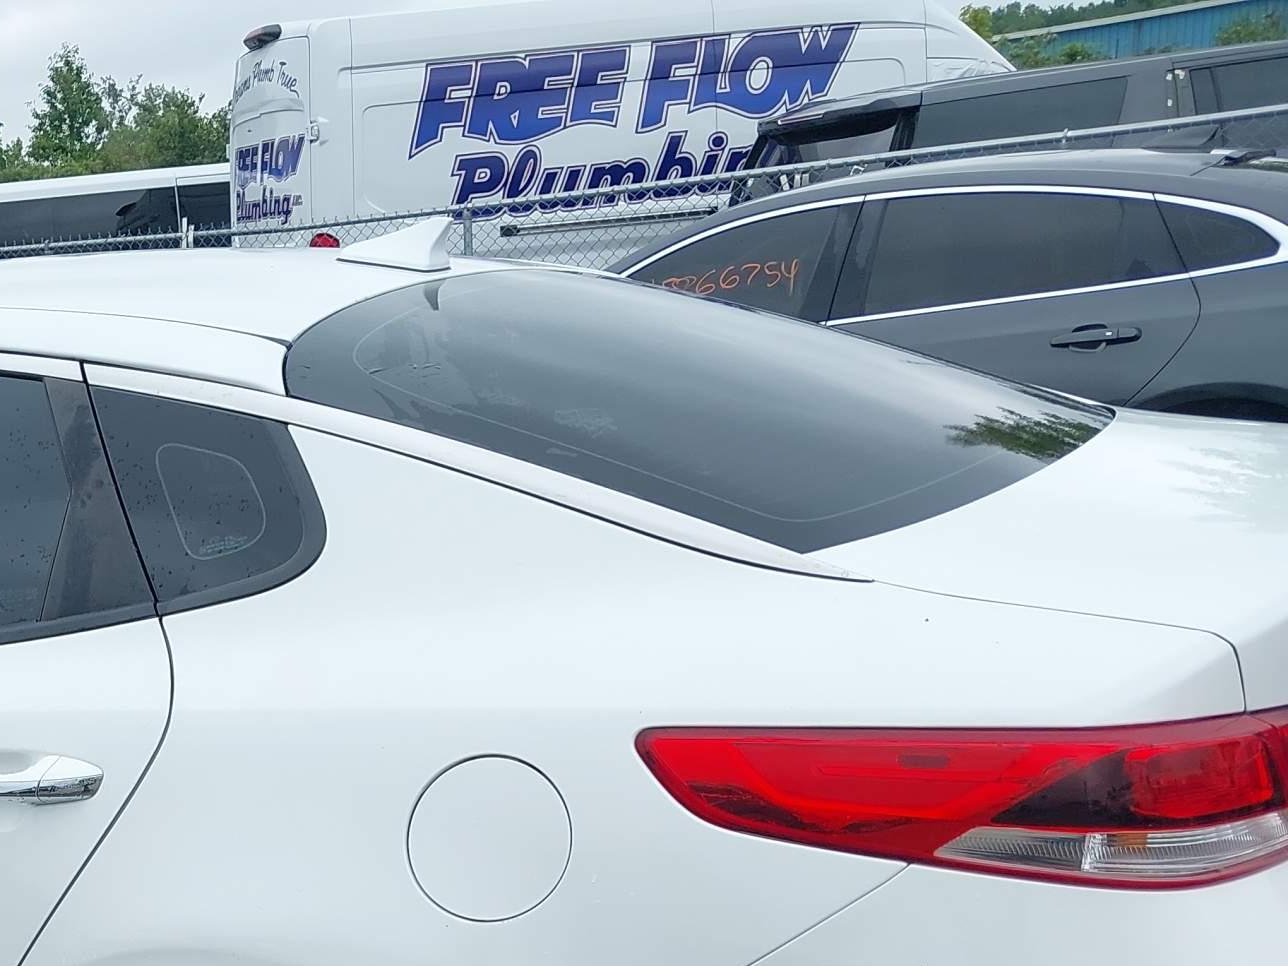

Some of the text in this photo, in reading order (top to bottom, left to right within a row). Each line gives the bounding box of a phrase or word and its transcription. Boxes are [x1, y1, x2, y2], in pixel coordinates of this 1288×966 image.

[277, 61, 300, 98] True
[409, 22, 861, 160] FREE FLOW
[260, 133, 306, 186] FLOW
